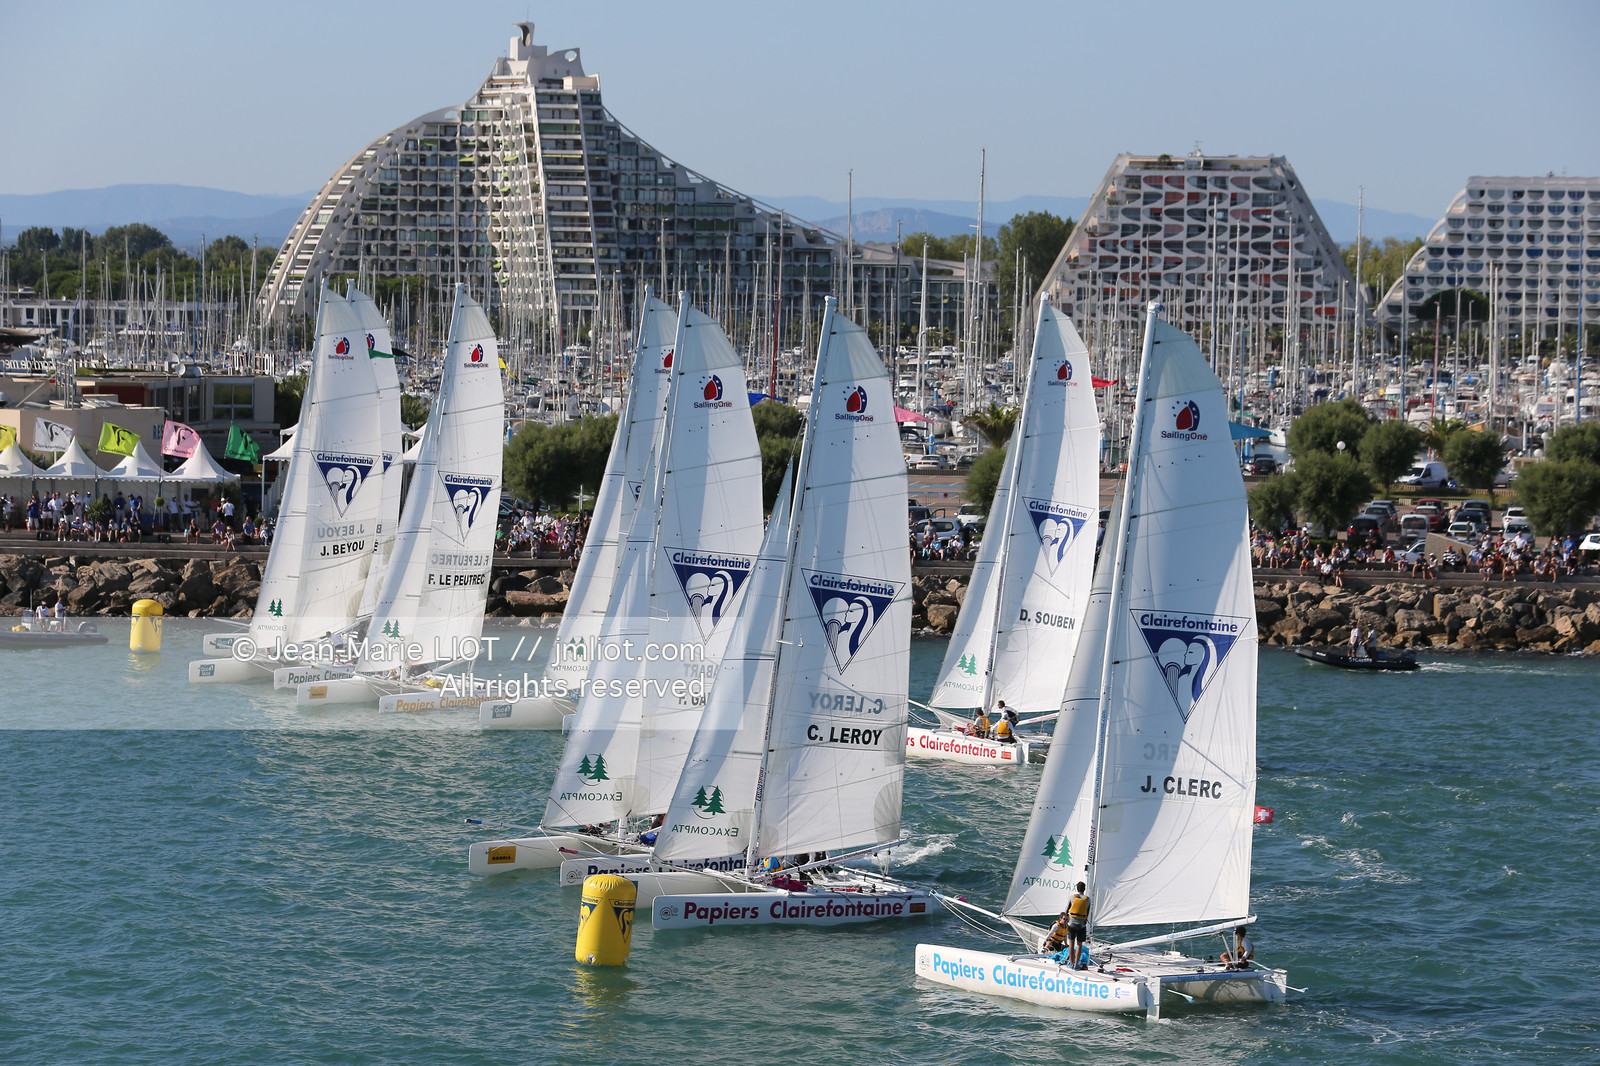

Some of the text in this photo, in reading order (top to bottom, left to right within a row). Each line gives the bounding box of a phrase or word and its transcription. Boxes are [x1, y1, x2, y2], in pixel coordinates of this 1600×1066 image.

[1047, 380, 1078, 388] SailingOne
[693, 401, 733, 410] SailingOne
[834, 413, 874, 423] SailingOne
[1161, 430, 1208, 442] SailingOne
[317, 452, 374, 465] Clairefontaine
[444, 474, 493, 486] Clairefontaine
[1029, 500, 1088, 519] Clairefontaine
[320, 546, 330, 557] J.
[332, 540, 365, 555] BEYOU
[672, 552, 751, 570] Clairefontaine
[428, 574, 486, 586] F. LE PEUTREC
[810, 574, 895, 597] Clairefontaine
[1019, 608, 1076, 630] D. SOUBEN
[1140, 613, 1238, 633] Clairefontaine
[288, 672, 320, 684] Papiers
[396, 698, 434, 712] Papiers
[807, 724, 883, 745] C. LEROY
[919, 735, 997, 758] Clairefontaine
[1140, 775, 1223, 799] J. CLERC
[683, 897, 903, 925] Papiers Clairefontaine
[933, 953, 1109, 999] Papiers Clairefontaine
